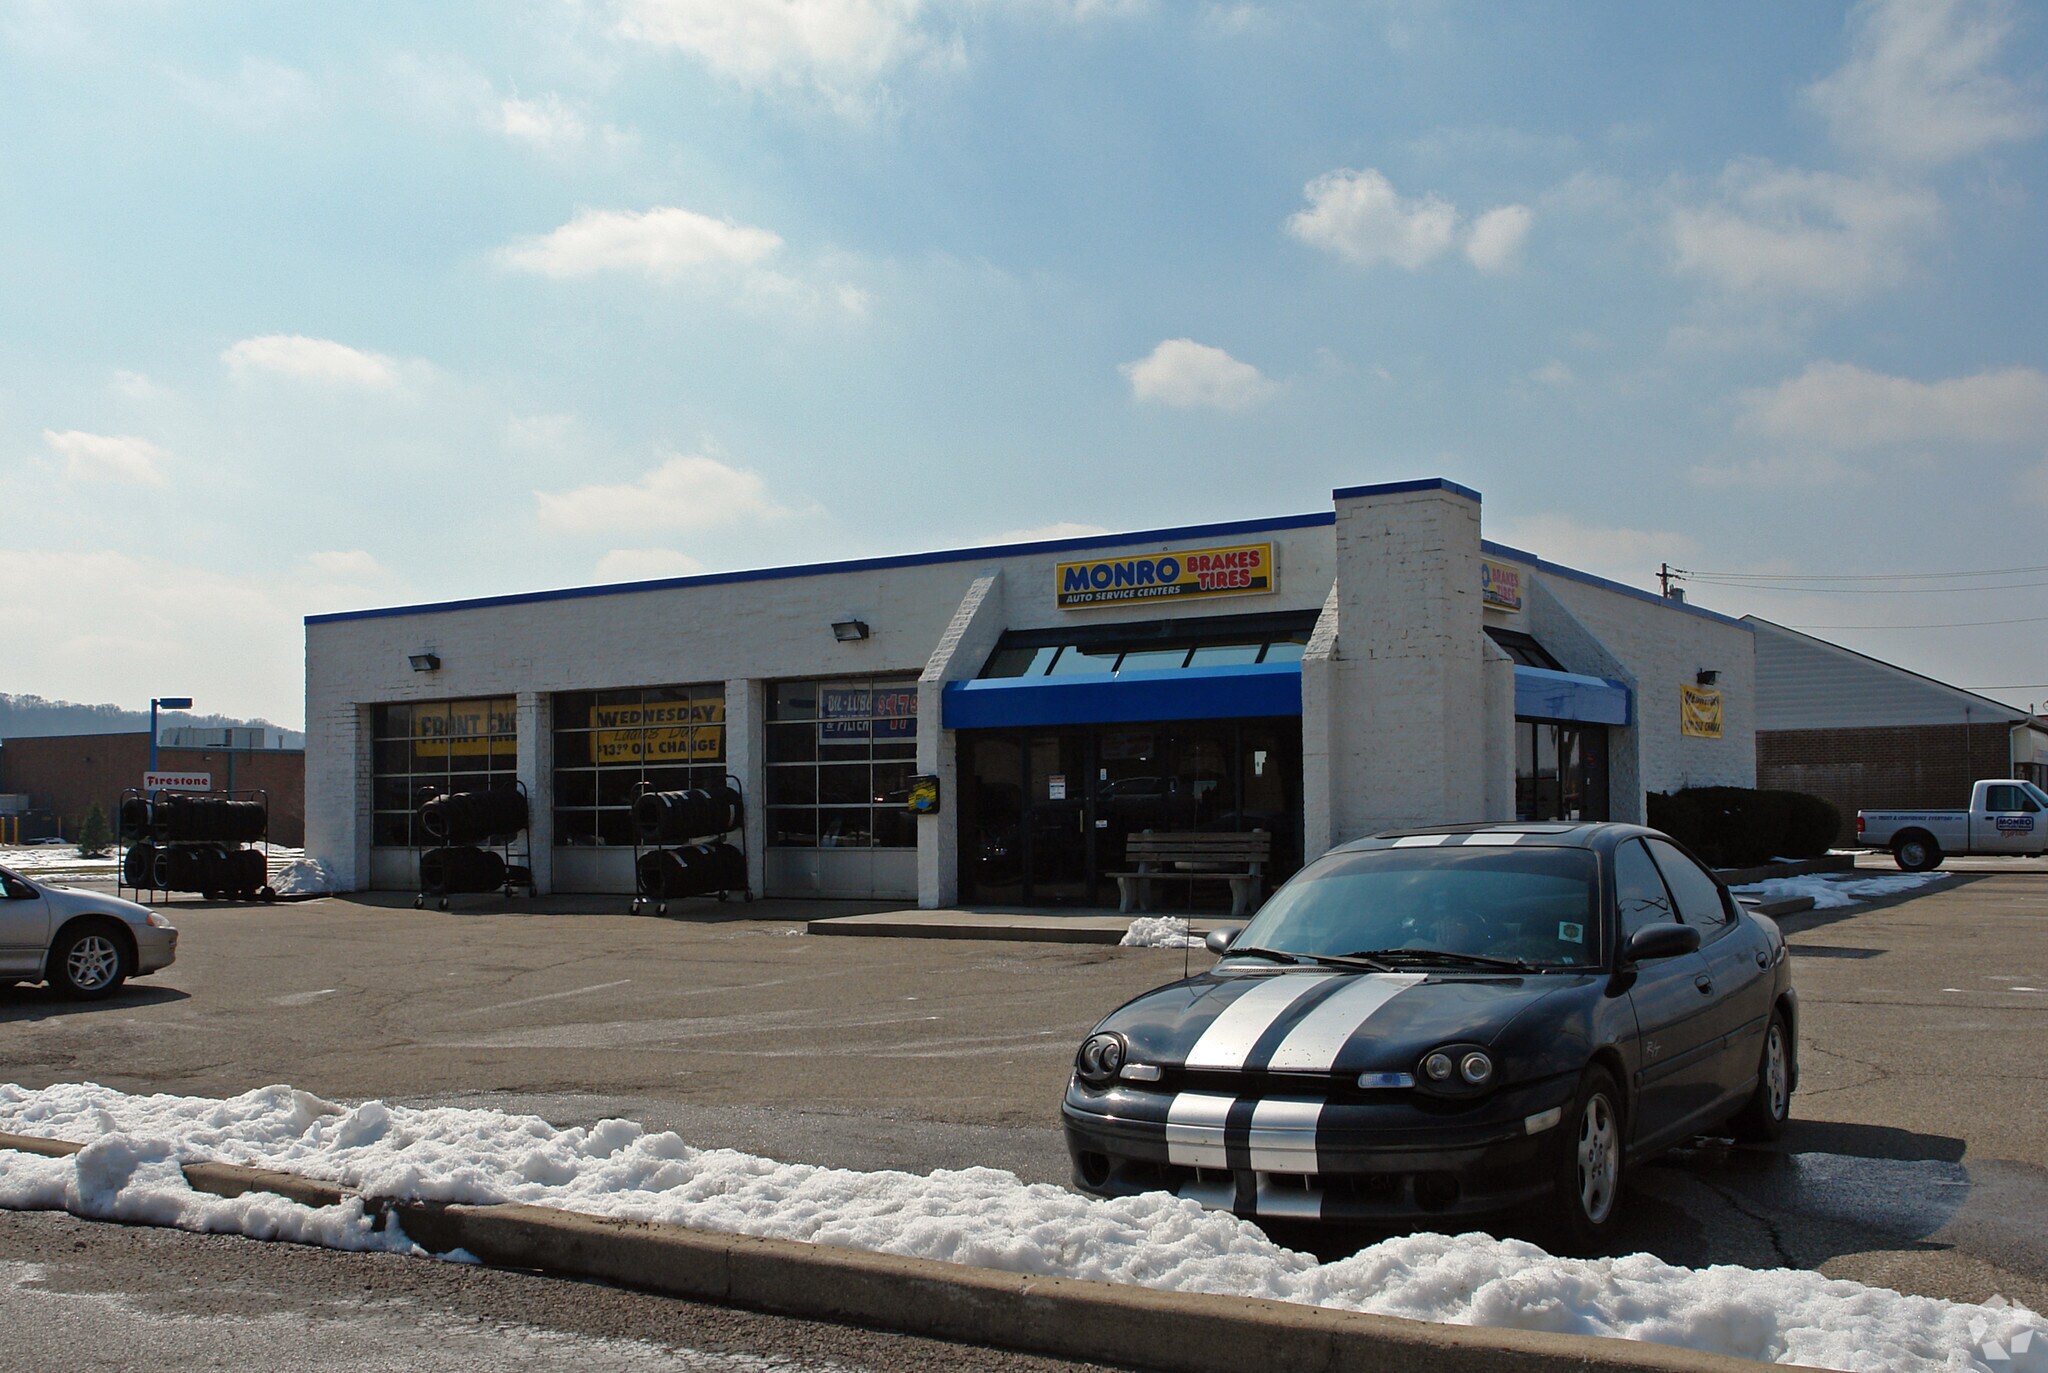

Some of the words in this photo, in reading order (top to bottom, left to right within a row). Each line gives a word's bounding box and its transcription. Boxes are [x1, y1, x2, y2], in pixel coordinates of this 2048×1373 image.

[1186, 550, 1261, 573] BRAKES
[1063, 556, 1181, 593] MONRO
[1197, 569, 1252, 591] TIRES
[1066, 594, 1093, 604] AUTO
[1095, 590, 1135, 601] SERVICE
[1137, 585, 1181, 597] CENTERS
[597, 705, 716, 728] WEDNESDAY
[421, 714, 480, 744] FRONT
[631, 743, 654, 755] OIL
[659, 740, 717, 754] CHANGE
[147, 776, 208, 787] Firestone
